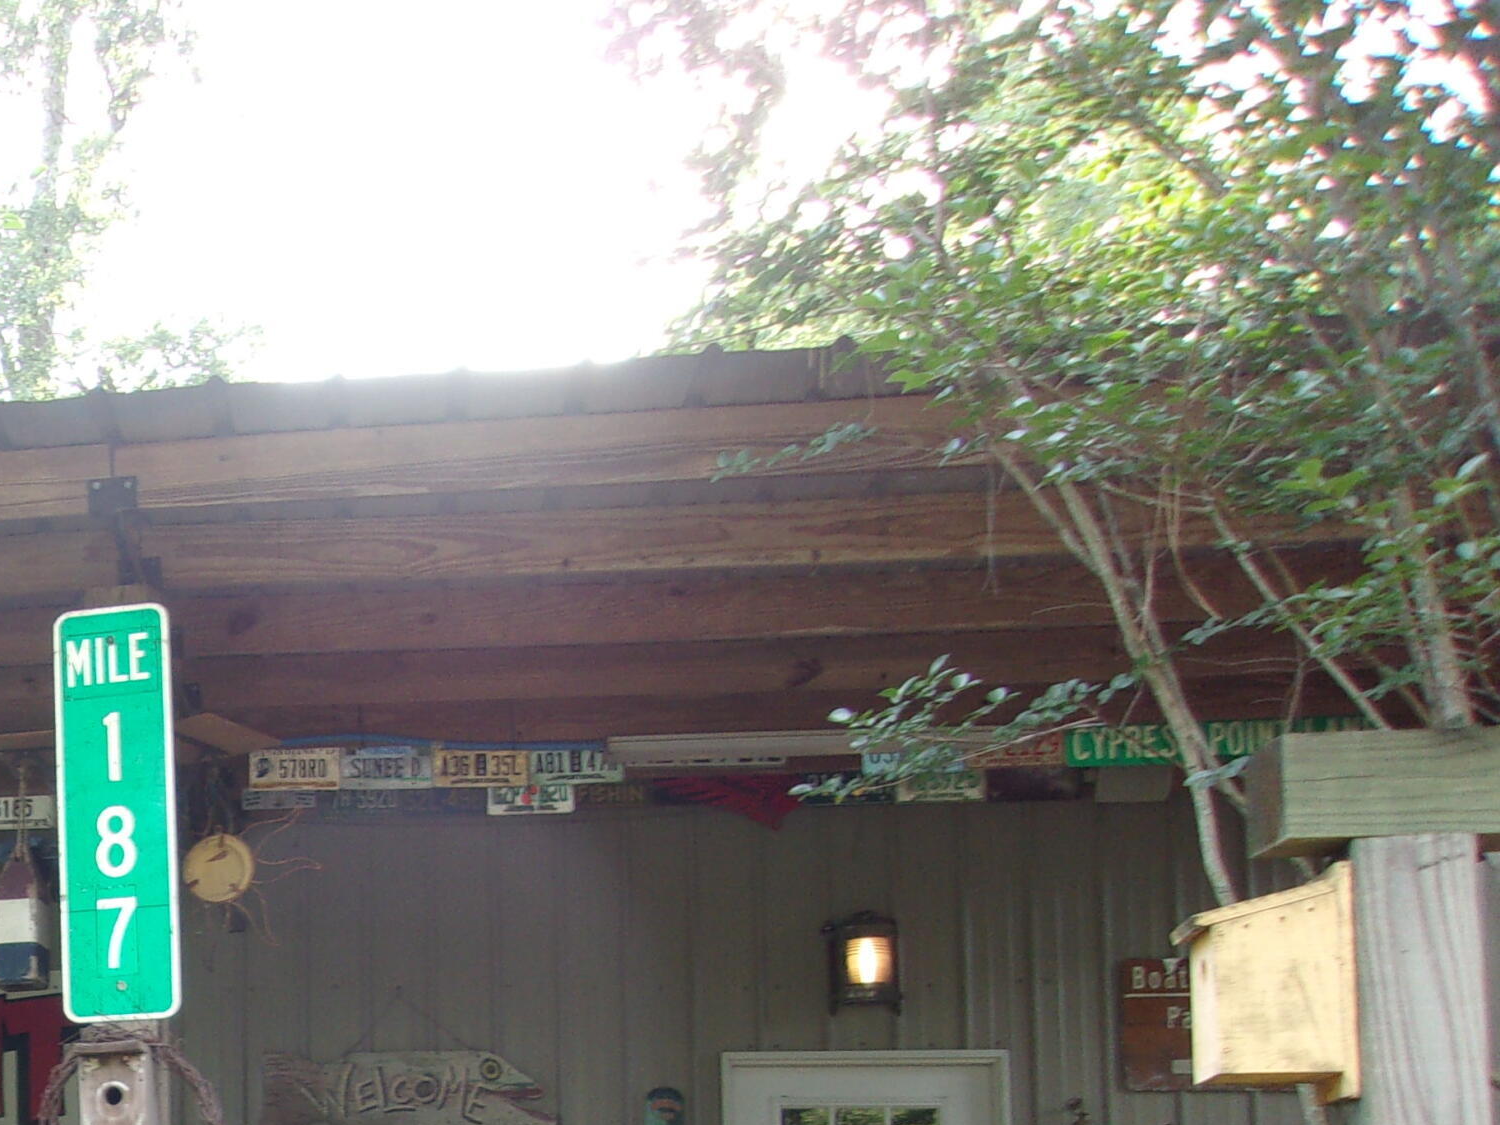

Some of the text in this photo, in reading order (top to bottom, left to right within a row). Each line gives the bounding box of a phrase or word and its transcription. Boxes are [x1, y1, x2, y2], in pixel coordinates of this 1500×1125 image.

[66, 631, 152, 688] MILE
[1071, 725, 1186, 761] CYPRES
[297, 1062, 486, 1125] WELCOME
